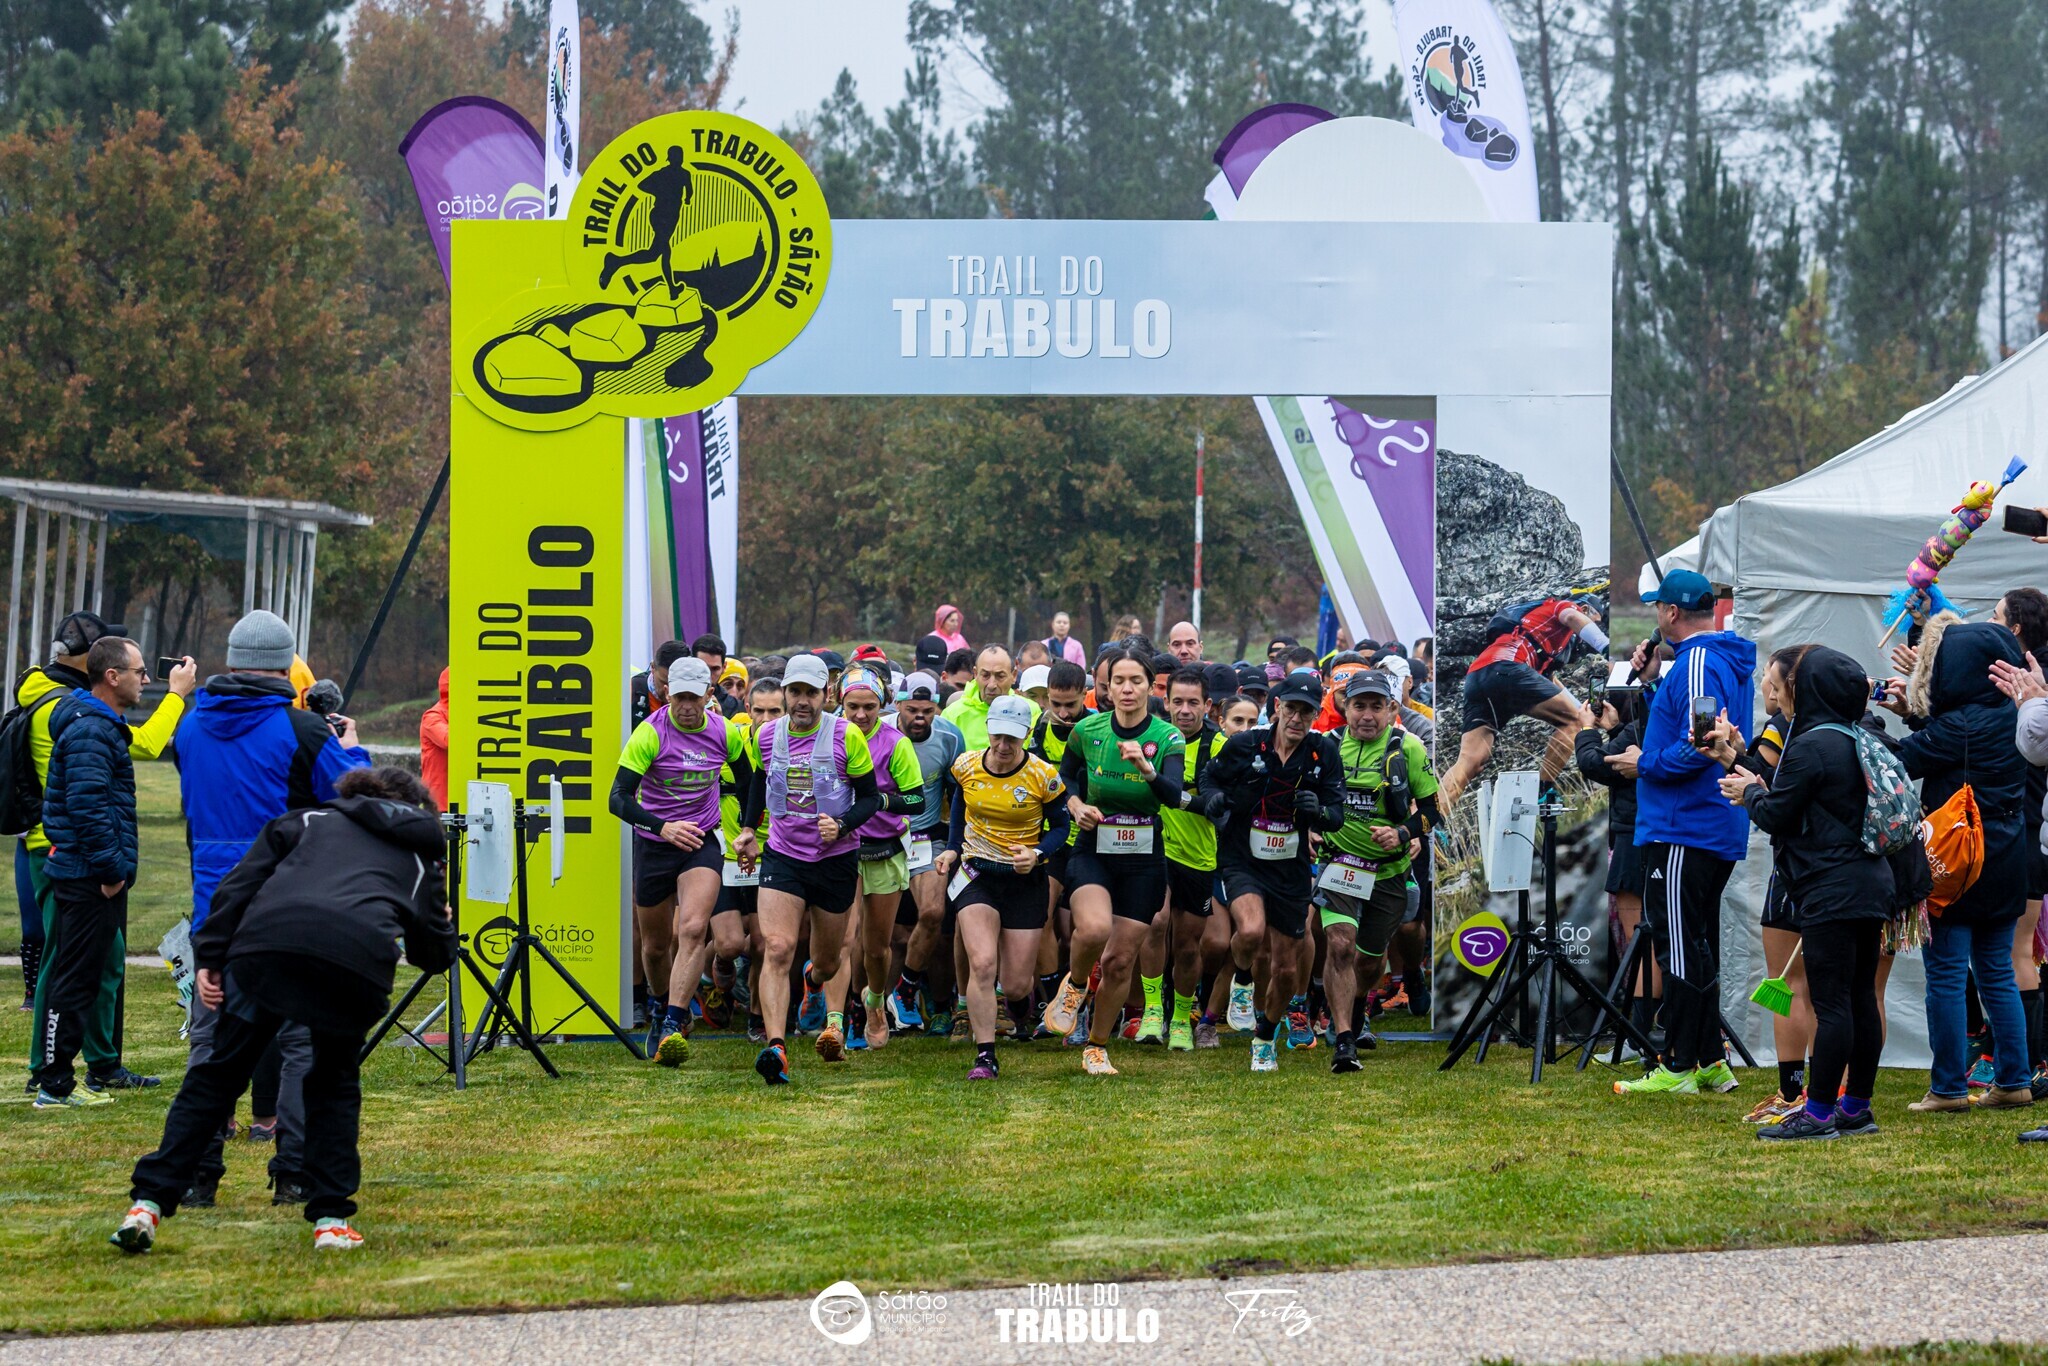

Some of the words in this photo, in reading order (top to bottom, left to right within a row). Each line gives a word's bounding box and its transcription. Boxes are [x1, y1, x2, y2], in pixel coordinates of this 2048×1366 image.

[583, 177, 628, 247] TRAIL
[619, 142, 658, 178] DO
[691, 128, 798, 200] TRABULO
[774, 226, 820, 309] SÁTÃO
[948, 255, 1044, 296] TRAIL
[1060, 255, 1104, 296] DO
[892, 298, 1173, 358] TRABULO
[477, 603, 523, 651] DO
[526, 525, 594, 843] TRABULO
[477, 670, 522, 779] TRAIL
[1117, 830, 1135, 841] 188
[1266, 836, 1285, 847] 108
[1343, 869, 1355, 882] 15
[534, 923, 594, 942] Sátão
[45, 1009, 60, 1065] Joma
